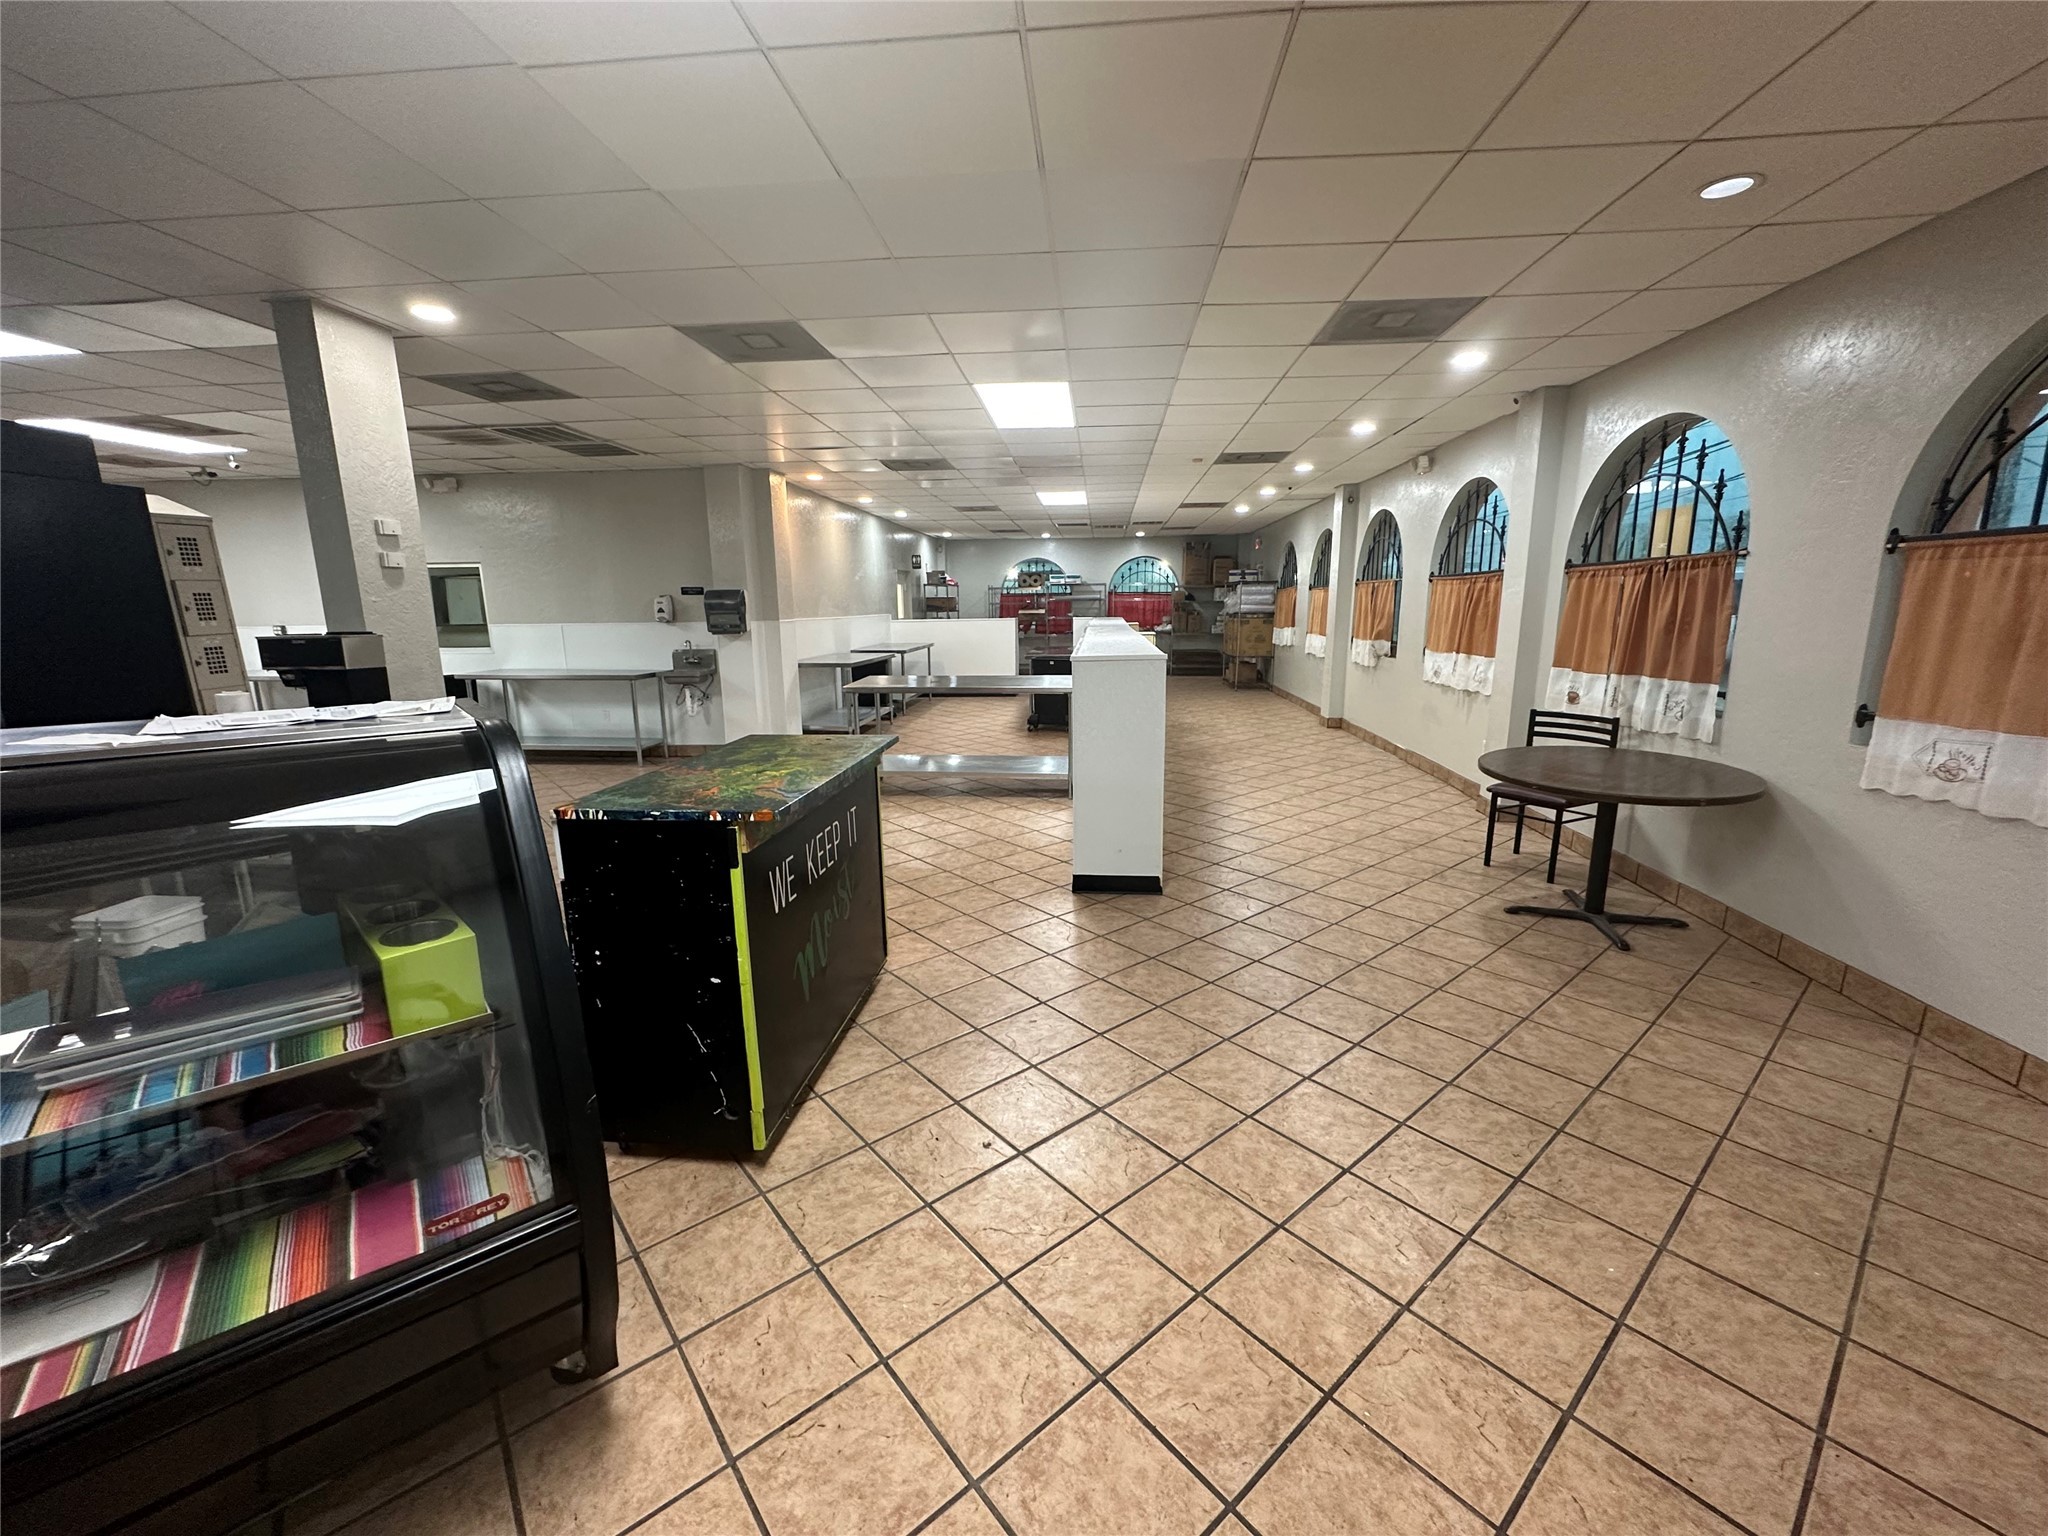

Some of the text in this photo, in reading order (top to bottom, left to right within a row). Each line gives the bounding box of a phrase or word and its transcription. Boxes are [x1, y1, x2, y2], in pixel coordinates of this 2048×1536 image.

[769, 805, 857, 914] WE KEEP IT
